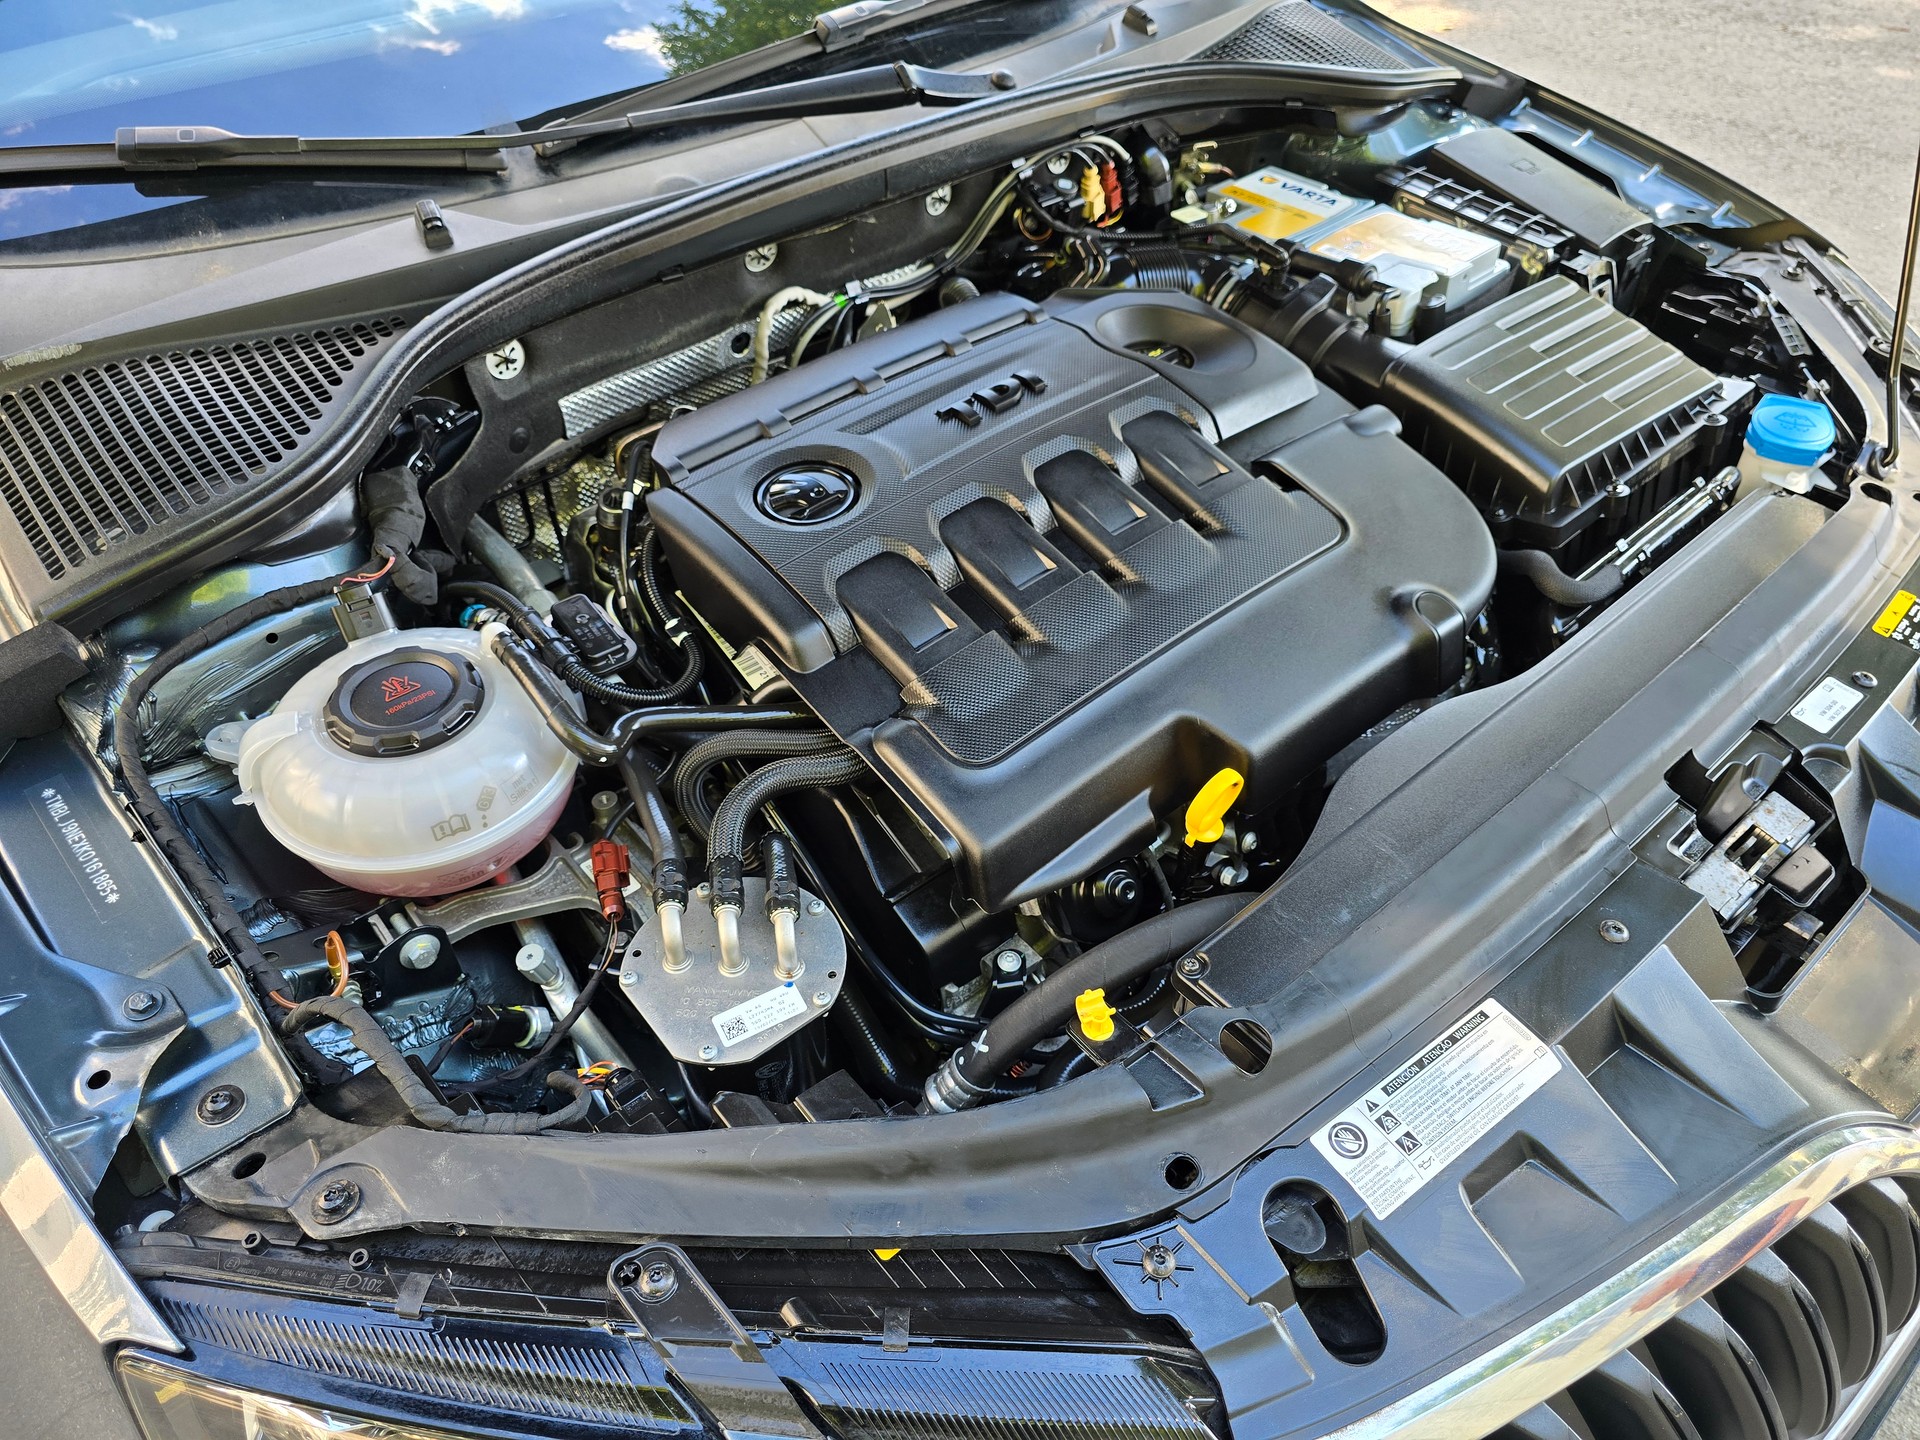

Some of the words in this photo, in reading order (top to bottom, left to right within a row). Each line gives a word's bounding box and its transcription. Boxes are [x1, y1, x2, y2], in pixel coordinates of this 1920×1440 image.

[1281, 182, 1337, 206] VARTA
[936, 370, 1046, 427] TDI
[510, 778, 539, 802] Silikat
[458, 869, 485, 882] min
[1386, 1065, 1419, 1093] ATENCIÓN
[1420, 1037, 1453, 1066] ATENÇÃO
[1453, 1014, 1485, 1039] WARNING
